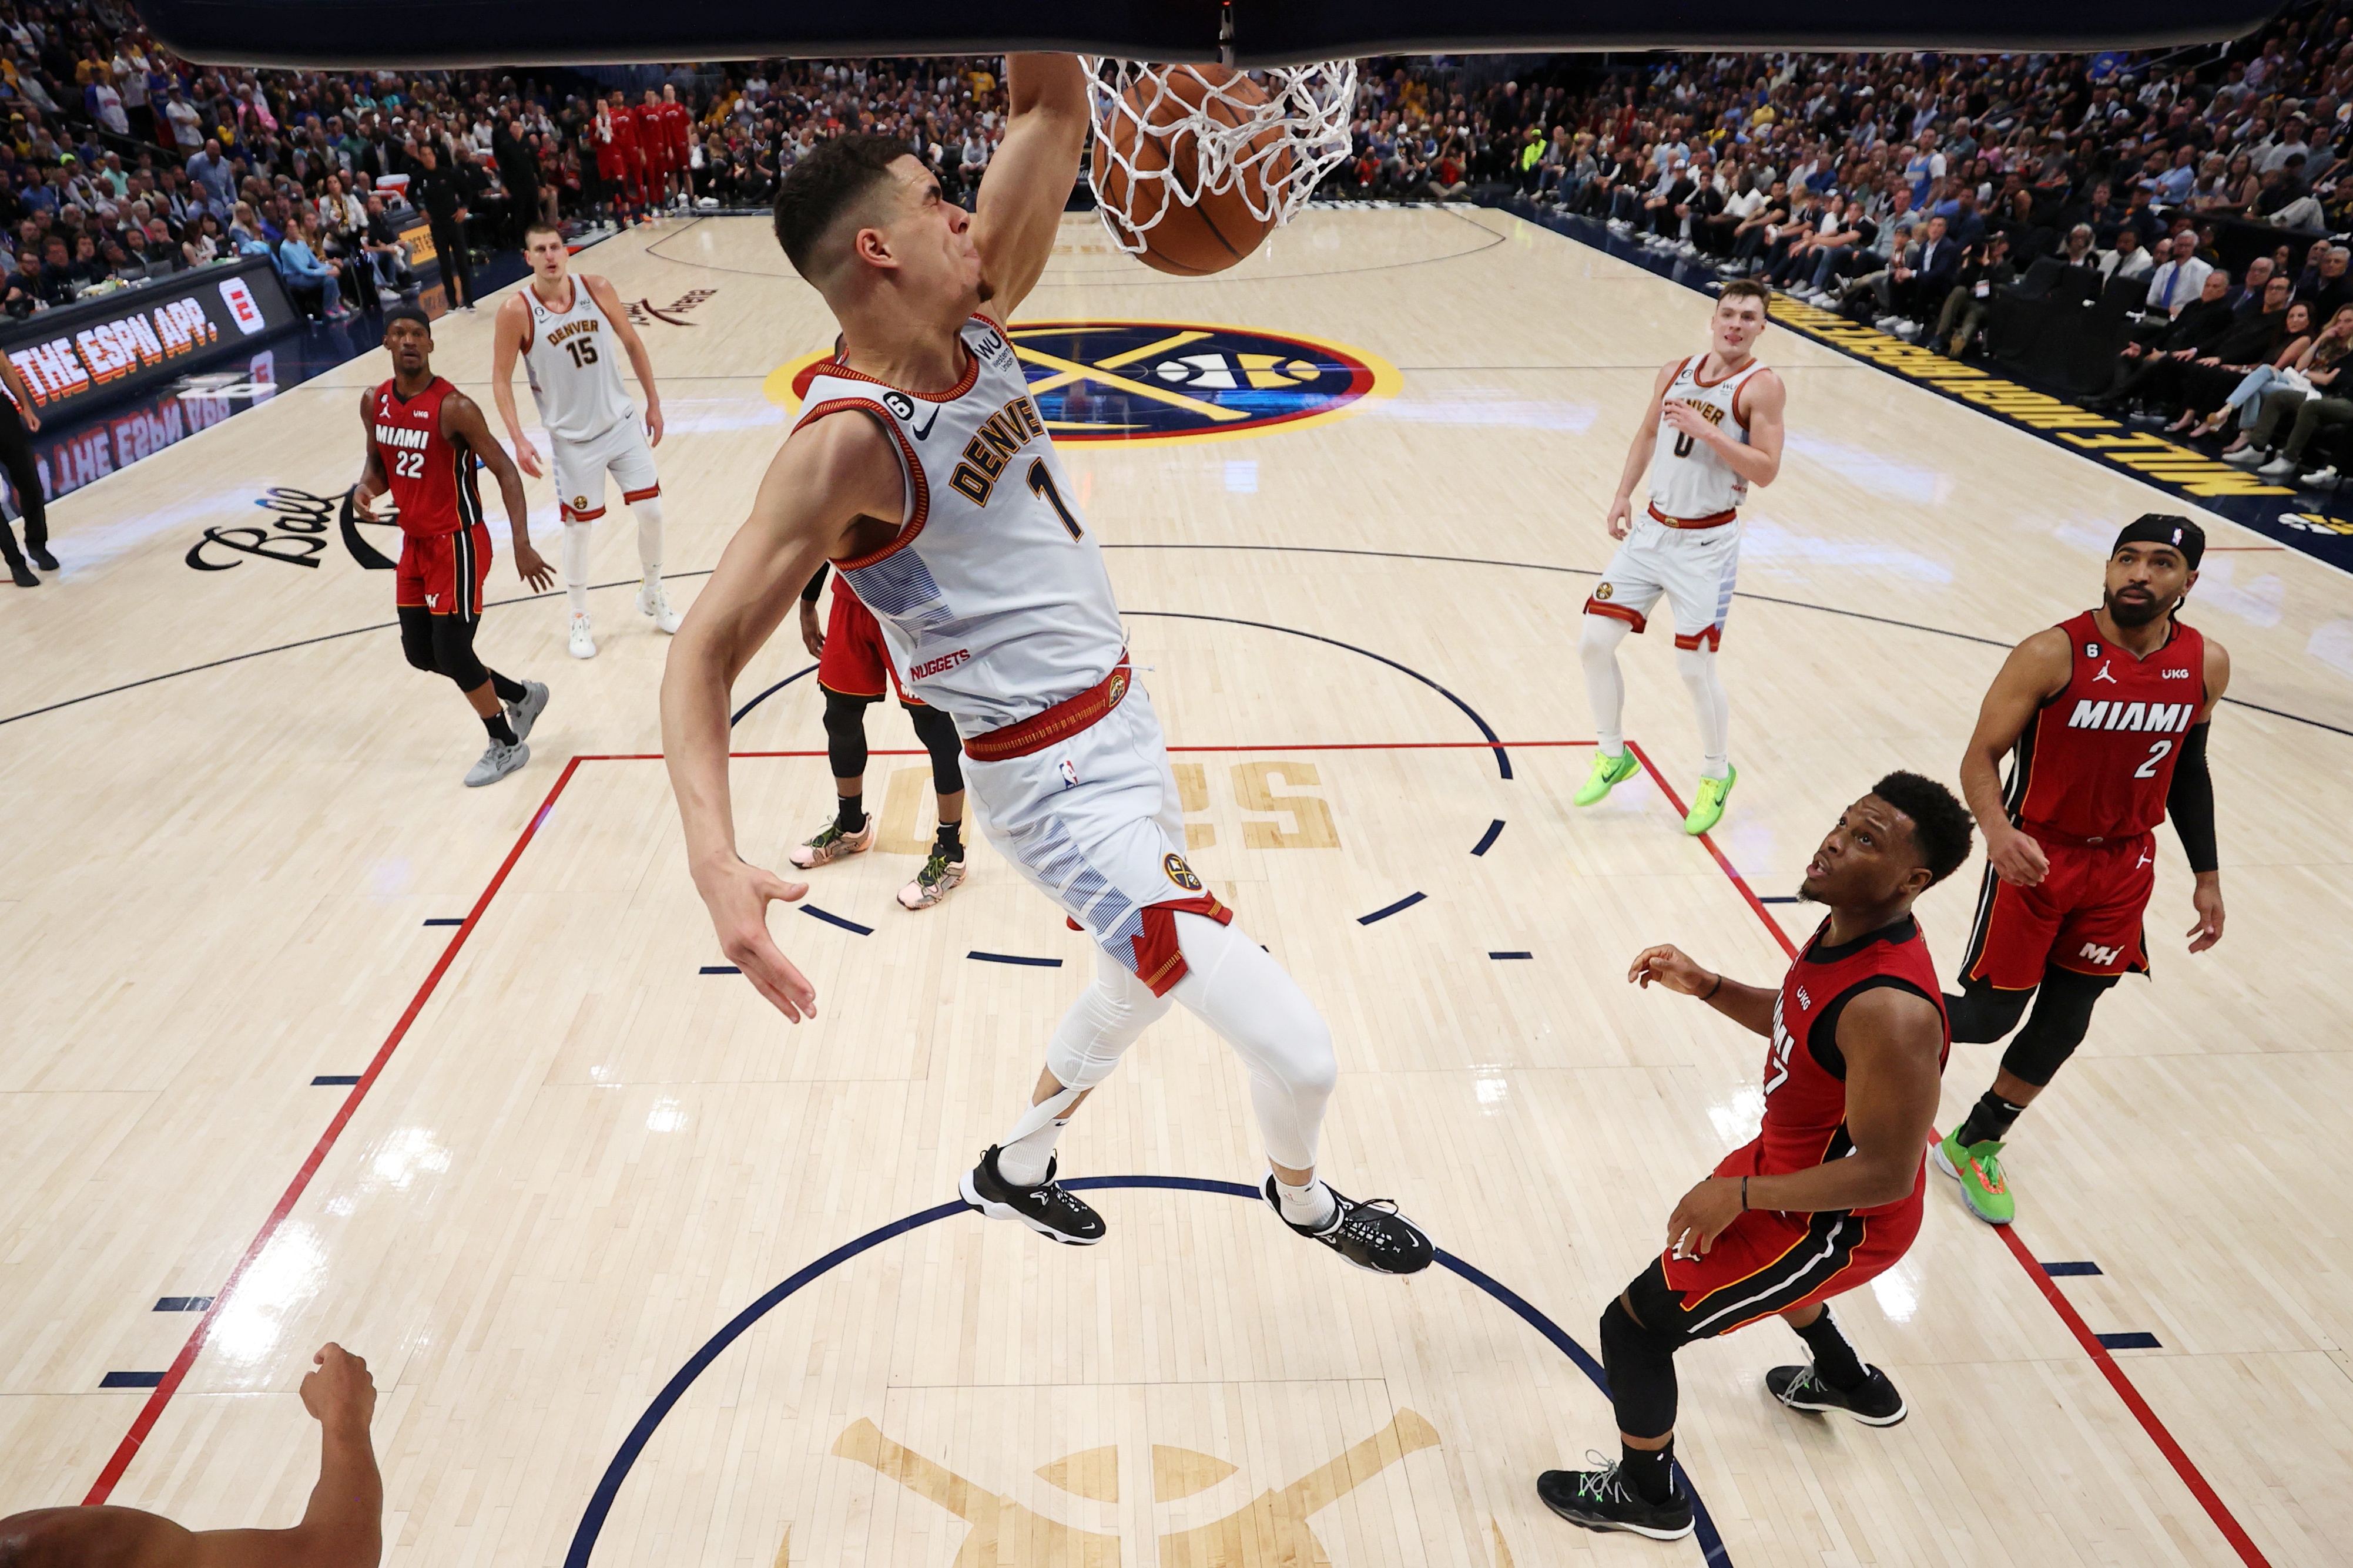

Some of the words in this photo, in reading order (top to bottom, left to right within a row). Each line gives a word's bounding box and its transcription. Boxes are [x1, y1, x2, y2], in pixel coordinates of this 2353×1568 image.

[547, 319, 599, 347] DENVER
[974, 329, 1002, 360] WU
[8, 337, 89, 405] THE
[76, 313, 162, 385] ESPN
[566, 336, 598, 368] 15
[991, 347, 1011, 368] Western
[1000, 357, 1014, 372] Union
[413, 409, 429, 419] UKG
[886, 395, 911, 418] 6
[1929, 379, 2123, 429] HIGH
[375, 424, 430, 450] MIAMI
[948, 396, 1045, 508] DENVE
[395, 450, 425, 479] 22
[2055, 431, 2298, 497] MILE
[1026, 456, 1084, 543] 1
[185, 487, 335, 571] Ball
[910, 648, 971, 682] NUGGETS
[2087, 643, 2099, 658] 6
[2161, 669, 2190, 679] UKG
[2067, 699, 2194, 733] MIAMI
[2133, 739, 2173, 778] 2
[1796, 985, 1811, 1011] UKG
[1765, 1056, 1789, 1096] 7
